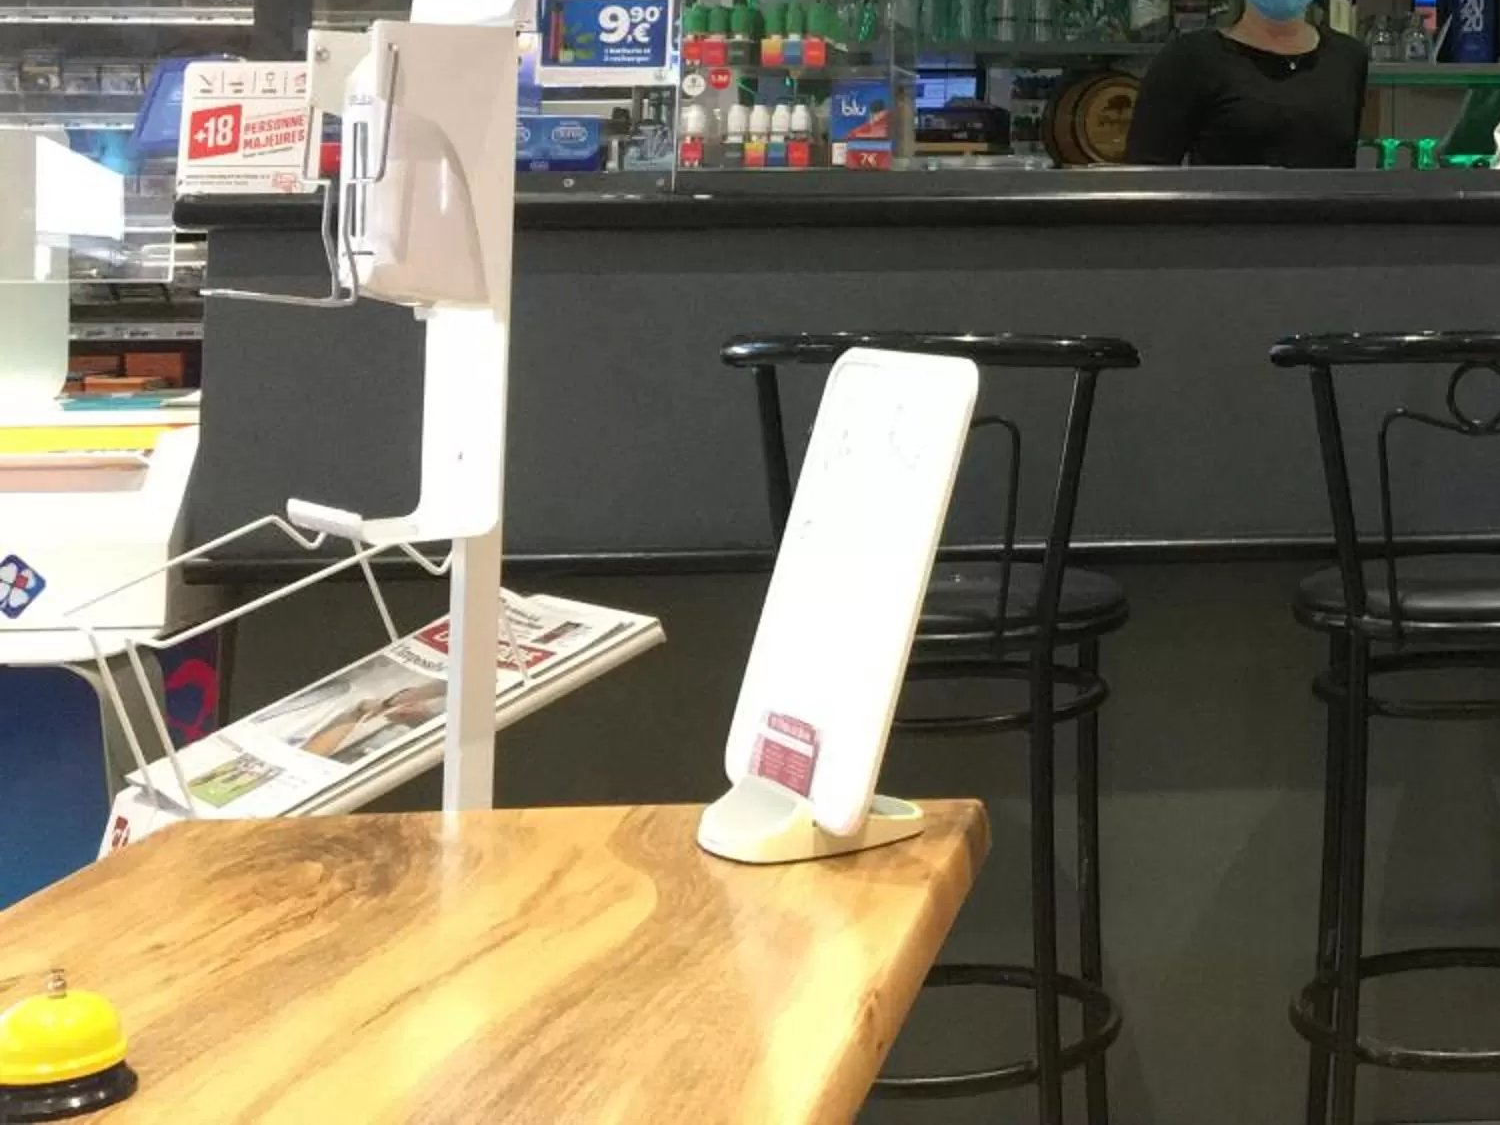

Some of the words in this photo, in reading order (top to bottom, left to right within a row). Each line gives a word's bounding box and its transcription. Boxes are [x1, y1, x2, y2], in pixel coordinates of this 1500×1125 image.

[841, 96, 867, 116] blu
[194, 113, 235, 148] +18
[244, 114, 304, 136] PERSONNE
